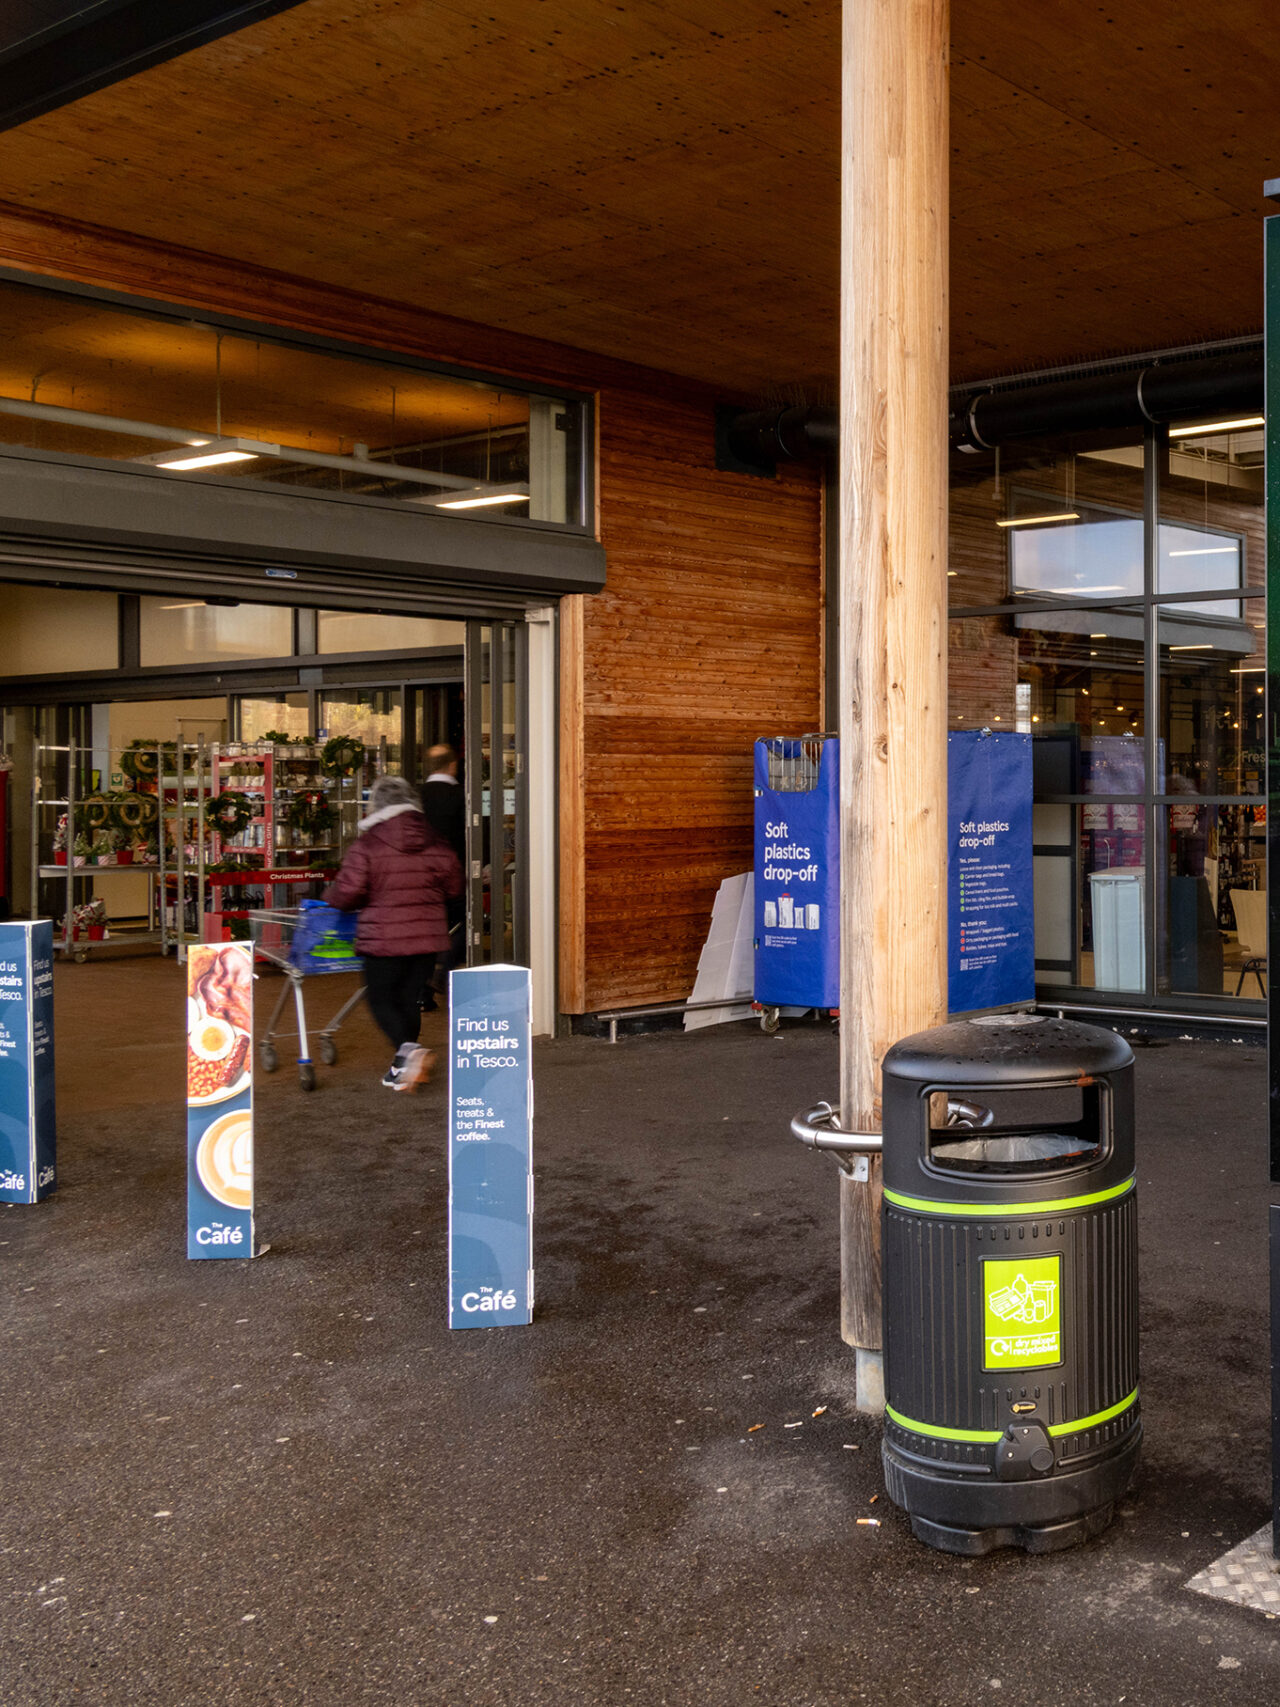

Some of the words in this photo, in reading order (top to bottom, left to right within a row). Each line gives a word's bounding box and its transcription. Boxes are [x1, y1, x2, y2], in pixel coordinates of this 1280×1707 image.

[1241, 750, 1266, 763] Fres
[764, 821, 789, 838] Soft
[960, 821, 976, 833] Soft
[977, 820, 1010, 835] plastics
[959, 834, 995, 850] drop-off
[764, 843, 811, 863] plastics
[763, 864, 818, 885] drop-off
[7, 961, 17, 972] us
[0, 975, 23, 986] stairs
[457, 1018, 488, 1032] Find
[492, 1020, 509, 1032] us
[457, 1035, 519, 1054] upstairs
[457, 1055, 470, 1068] in
[473, 1054, 519, 1068] Tesco.
[456, 1097, 485, 1106] Seats,
[456, 1108, 485, 1118] treats
[486, 1107, 495, 1117] &
[456, 1120, 473, 1130] the
[475, 1119, 505, 1129] Finest
[456, 1132, 491, 1142] coffee.
[196, 1226, 243, 1245] Café
[461, 1289, 517, 1313] Café
[1015, 1338, 1030, 1348] dry
[1031, 1334, 1056, 1346] mixed
[1013, 1344, 1058, 1357] recyclables
